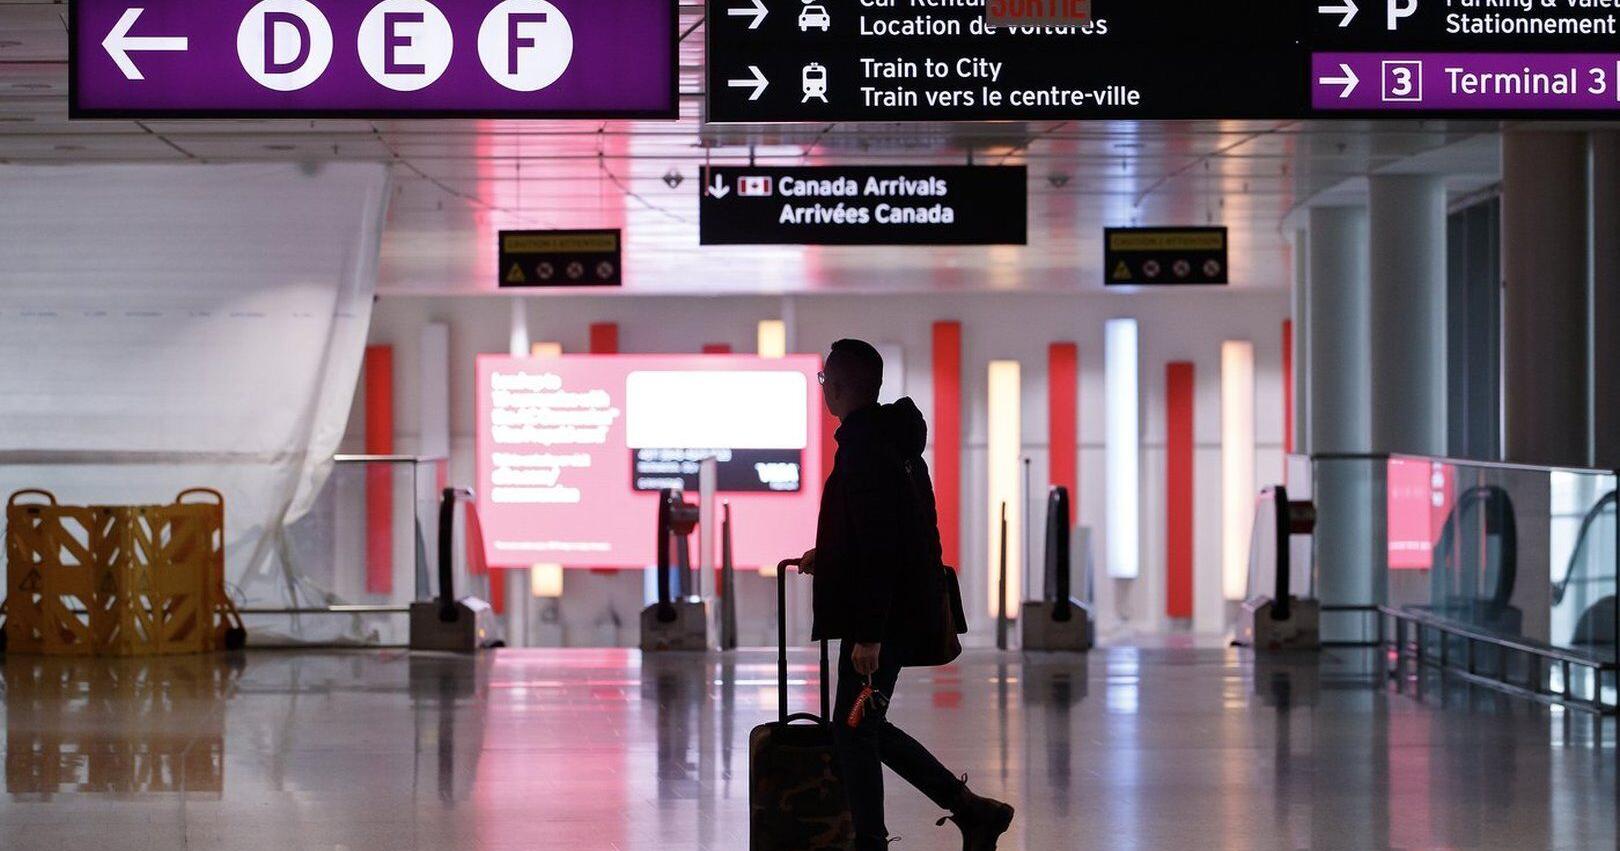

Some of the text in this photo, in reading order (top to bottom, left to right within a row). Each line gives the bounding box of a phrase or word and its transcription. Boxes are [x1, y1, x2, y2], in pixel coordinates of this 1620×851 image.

[860, 14, 960, 36] Location
[969, 15, 997, 36] de
[1387, 0, 1418, 30] P
[1446, 13, 1617, 34] Stationnement
[263, 12, 547, 74] D E F
[860, 57, 1003, 82] Train to City
[1445, 67, 1607, 95] Terminal 3
[1391, 67, 1413, 96] 3
[860, 85, 1141, 107] Train vers le centre-ville
[778, 175, 948, 197] Canada Arrivals
[779, 202, 954, 224] Arrivées Canada
